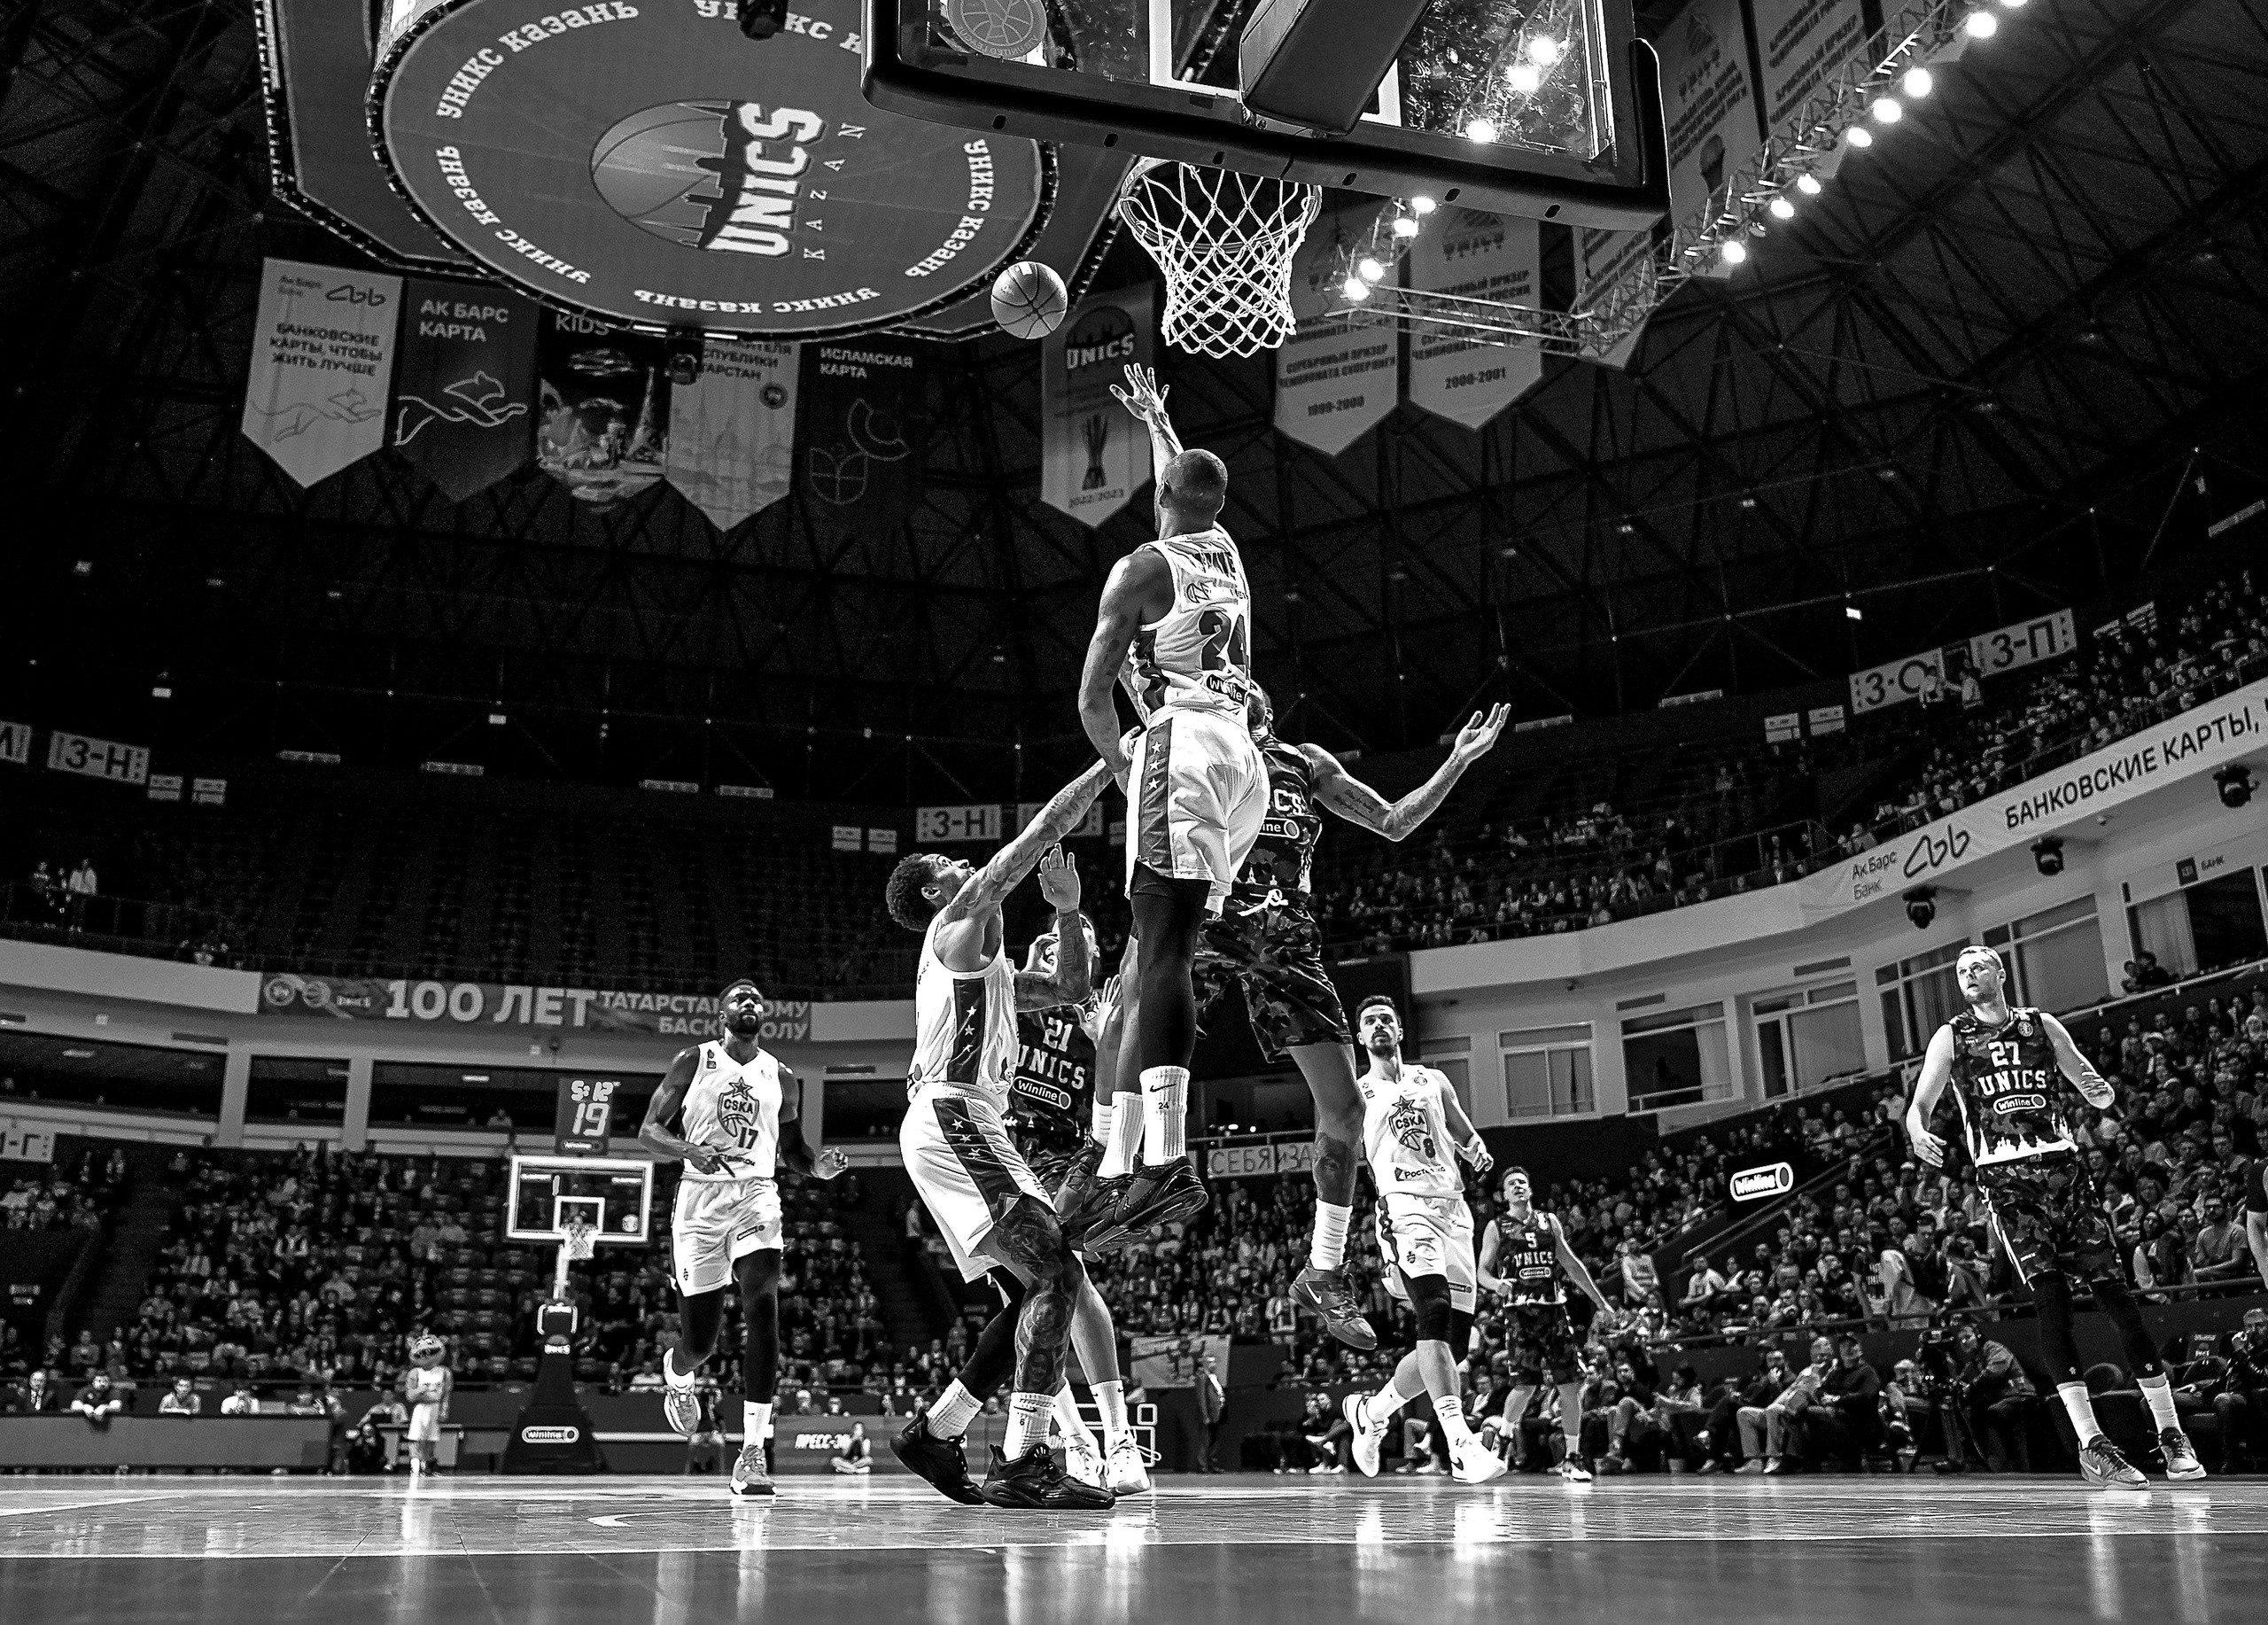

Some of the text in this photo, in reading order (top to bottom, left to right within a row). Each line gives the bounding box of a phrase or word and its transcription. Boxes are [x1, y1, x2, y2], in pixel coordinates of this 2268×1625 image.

[707, 102, 824, 257] UNICS
[804, 122, 867, 261] KAZAN
[420, 299, 509, 324] АК БАРС
[276, 323, 379, 346] БАНКОВСКИЕ
[419, 321, 486, 343] КАРТА
[555, 314, 610, 336] KIDS
[329, 344, 383, 362] ЧТОБЫ
[704, 346, 779, 368] СПУБЛИКИ
[820, 347, 913, 368] ИСЛАМСКАЯ
[1066, 332, 1135, 369] UNICS
[272, 353, 376, 377] ЖИТЬ ЛУЧШЕ
[704, 362, 762, 382] ТАРСТАН
[820, 363, 867, 379] КАРТА
[1445, 367, 1506, 391] 2000-2001
[2005, 706, 2259, 829] БАНКОВСКИЕ КАРТЫ,
[1852, 851, 1897, 881] Ак Барс
[1854, 879, 1882, 900] Банк
[384, 980, 810, 1027] 100 ЛЕТ ТАТАРСТАОМУ
[658, 1015, 810, 1041] БАСКОЛУ
[1043, 1017, 1071, 1052] 21
[1017, 1043, 1086, 1090] UNICS
[1987, 1041, 2021, 1068] 27
[1018, 1079, 1058, 1103] Winline
[1977, 1069, 2047, 1096] UNICS
[724, 1099, 753, 1115] CSKA
[1998, 1099, 2031, 1111] Winline
[572, 1102, 610, 1137] 19
[1395, 1115, 1425, 1130] CSKA
[738, 1126, 759, 1150] 17
[1422, 1138, 1436, 1158] 8
[1211, 1148, 1270, 1175] СЕБЯ
[1525, 1232, 1538, 1248] 5
[1514, 1251, 1554, 1268] UNICS
[795, 1434, 852, 1450] ПРЕСС-ЗО
